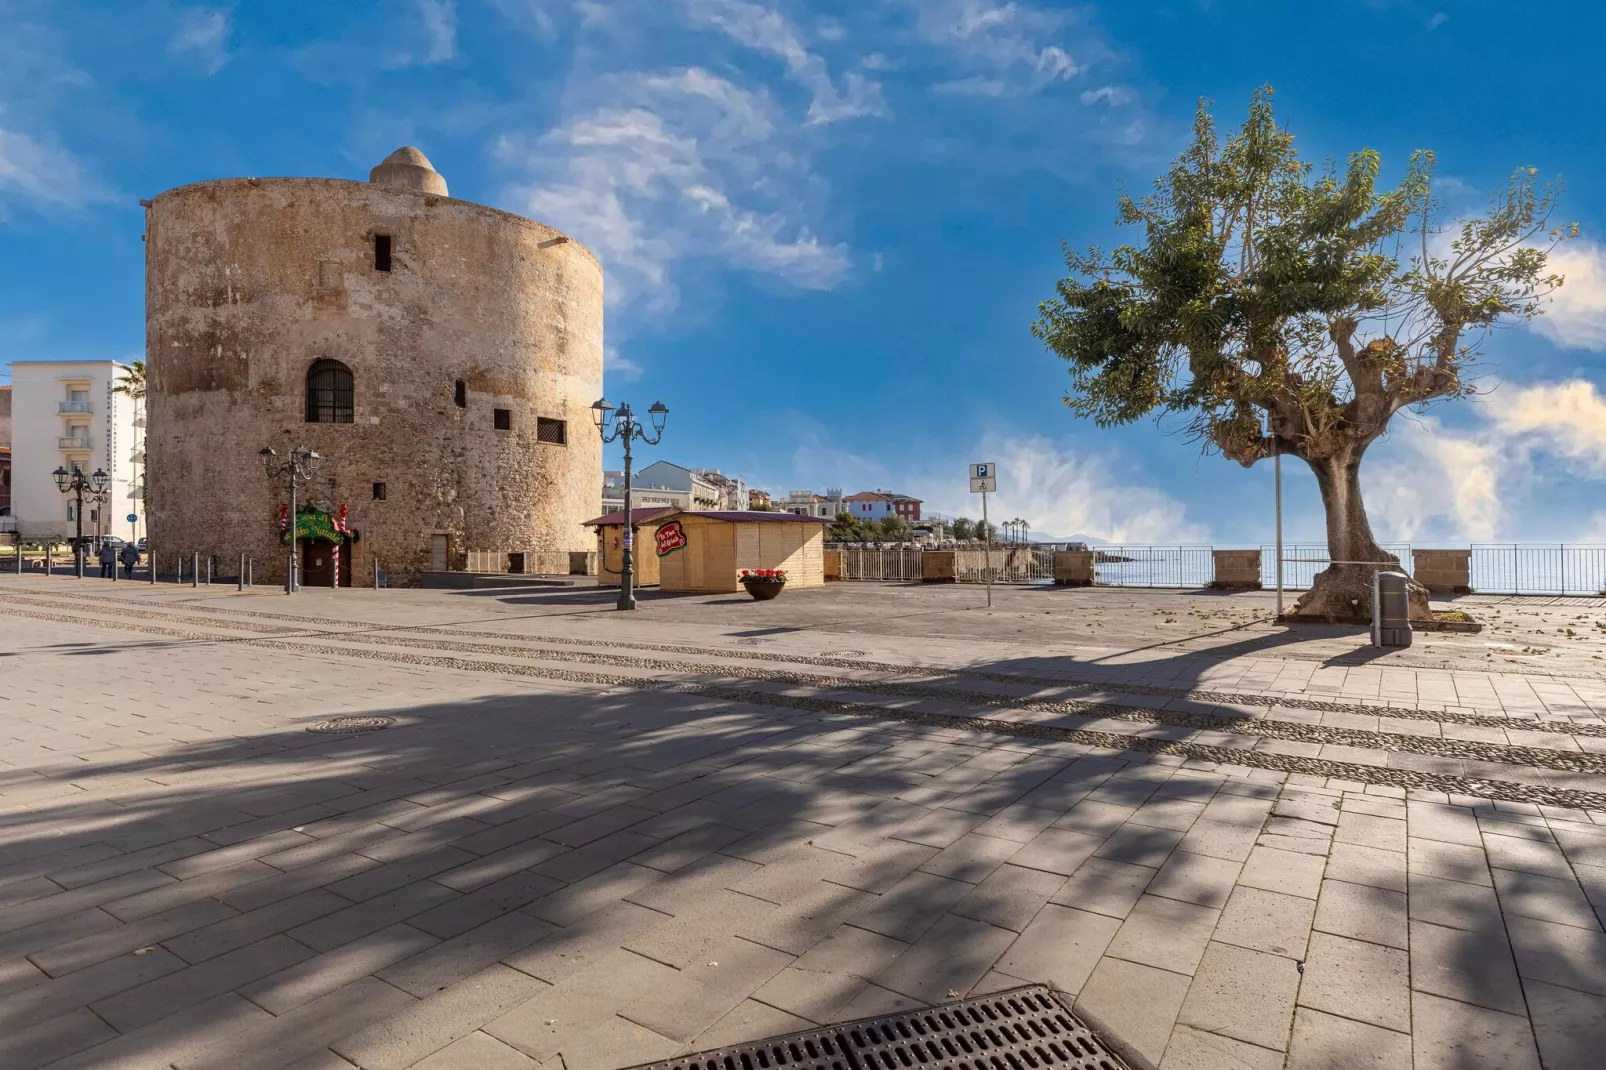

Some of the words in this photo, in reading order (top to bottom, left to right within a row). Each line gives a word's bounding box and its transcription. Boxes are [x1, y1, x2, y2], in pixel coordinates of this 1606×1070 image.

[978, 465, 986, 476] P
[284, 526, 309, 541] Bbbo
[311, 525, 340, 543] Natale
